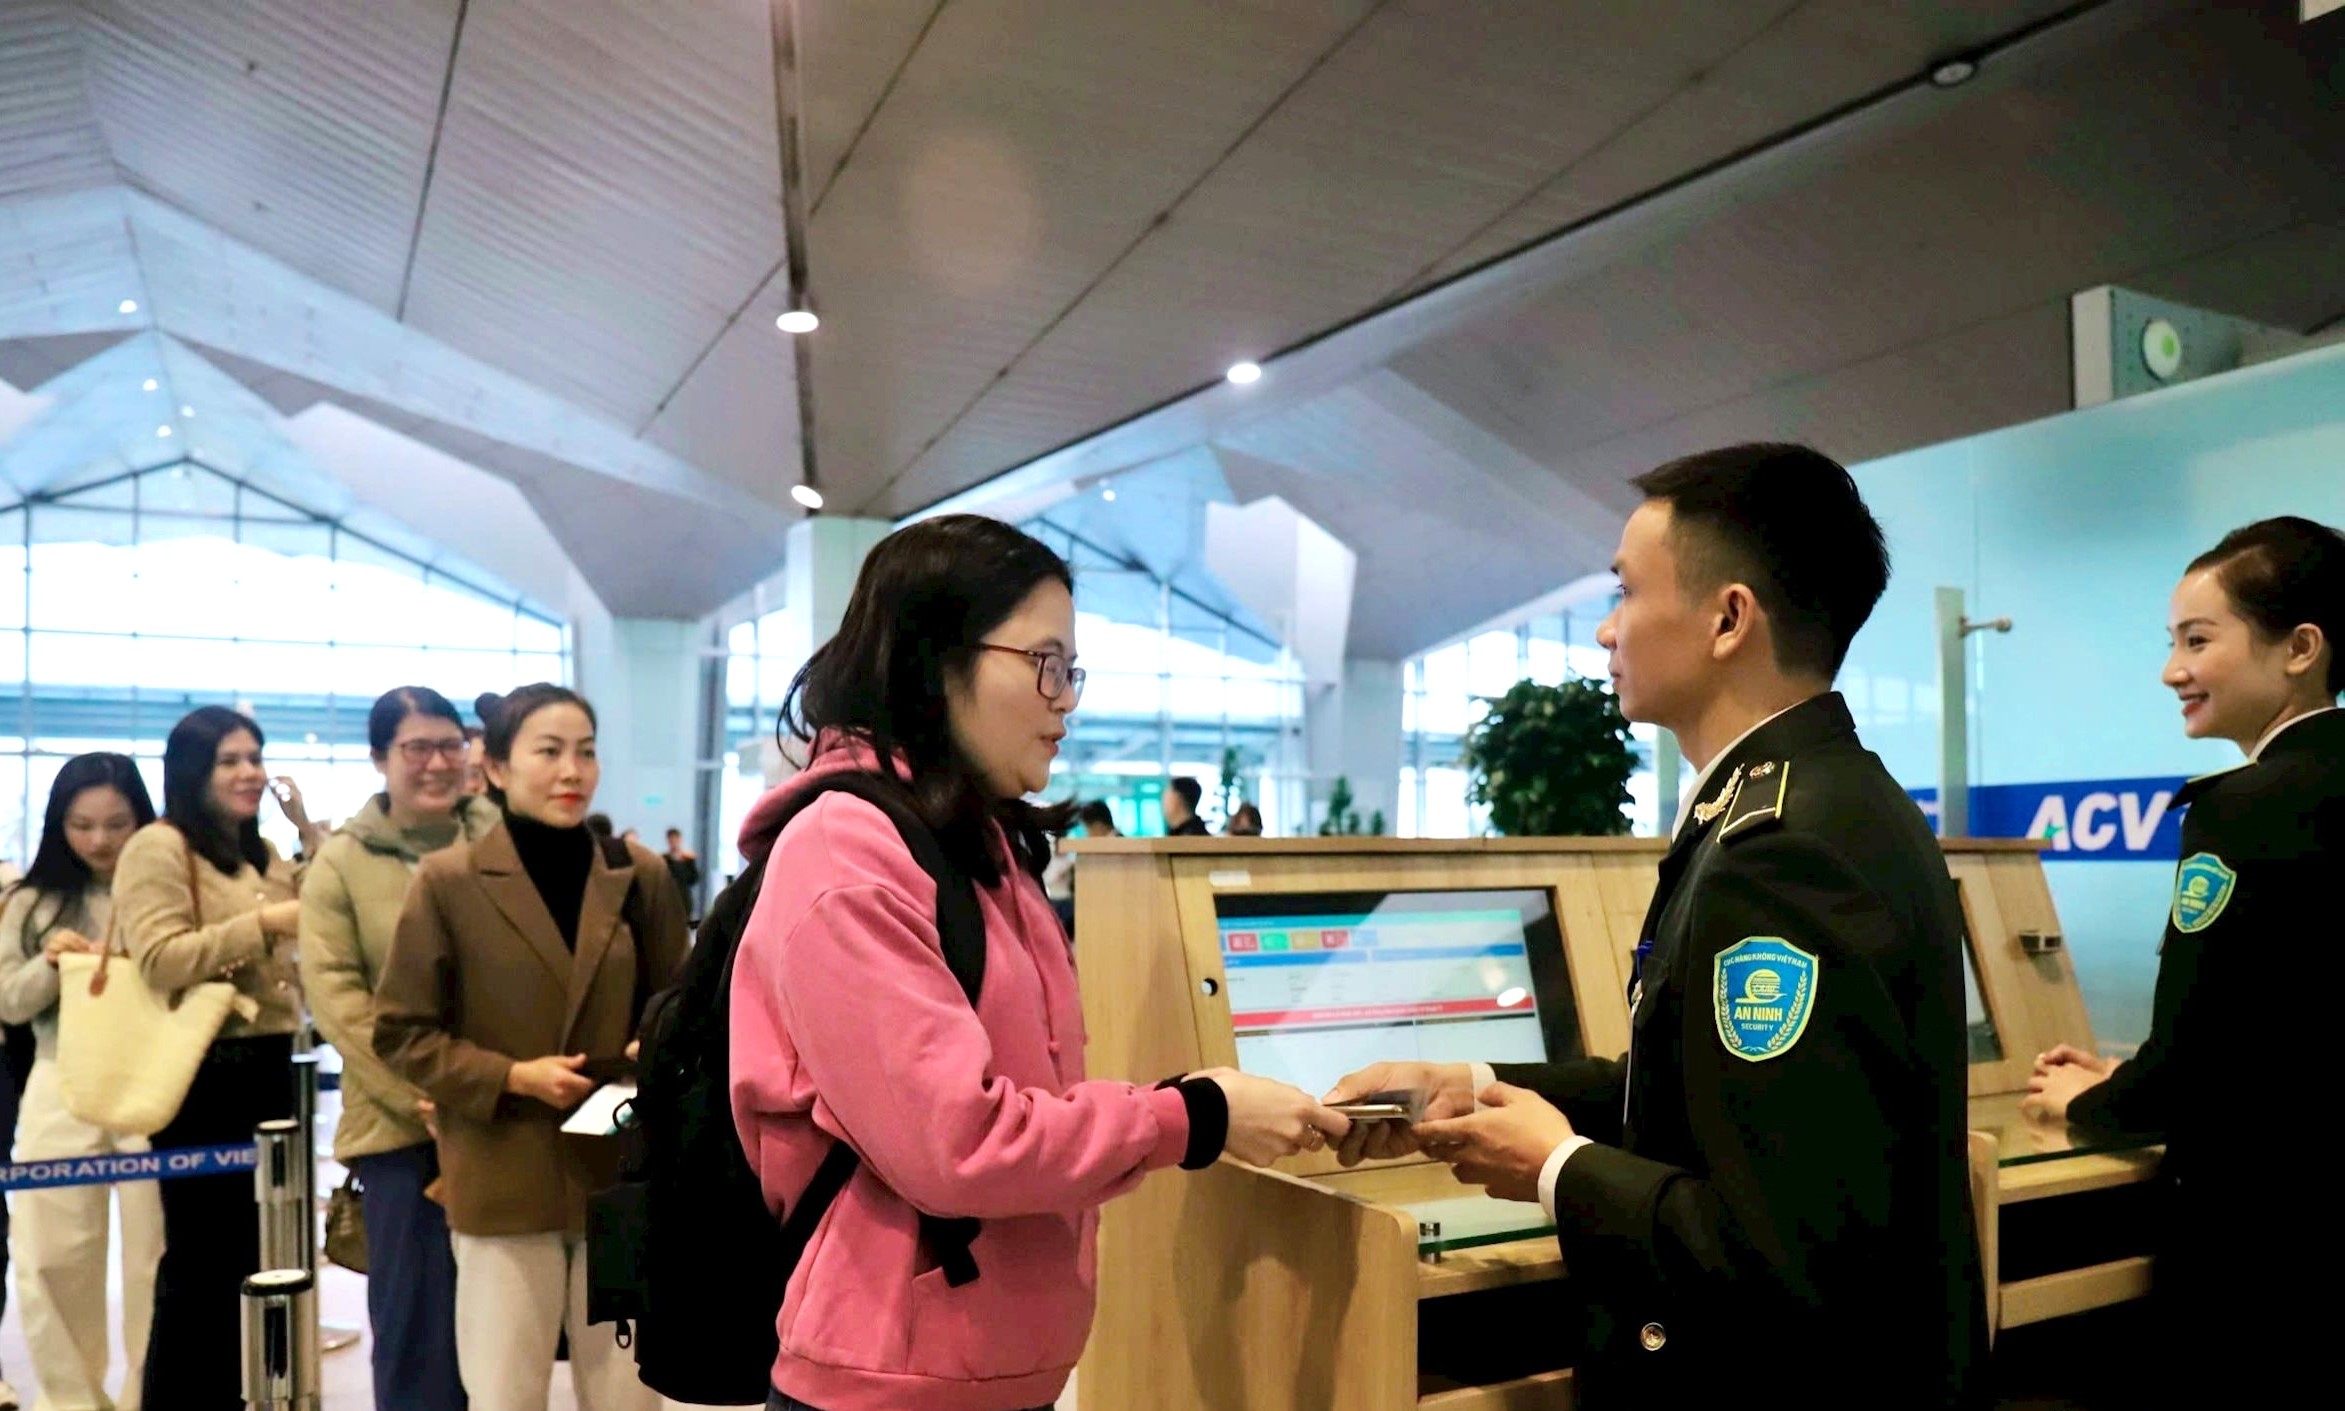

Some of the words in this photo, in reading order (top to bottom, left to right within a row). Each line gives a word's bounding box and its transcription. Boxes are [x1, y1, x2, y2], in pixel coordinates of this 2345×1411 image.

[2025, 791, 2173, 851] ACV
[1734, 1006, 1751, 1020] AN
[1753, 1007, 1783, 1021] NINH
[169, 1153, 205, 1170] OF
